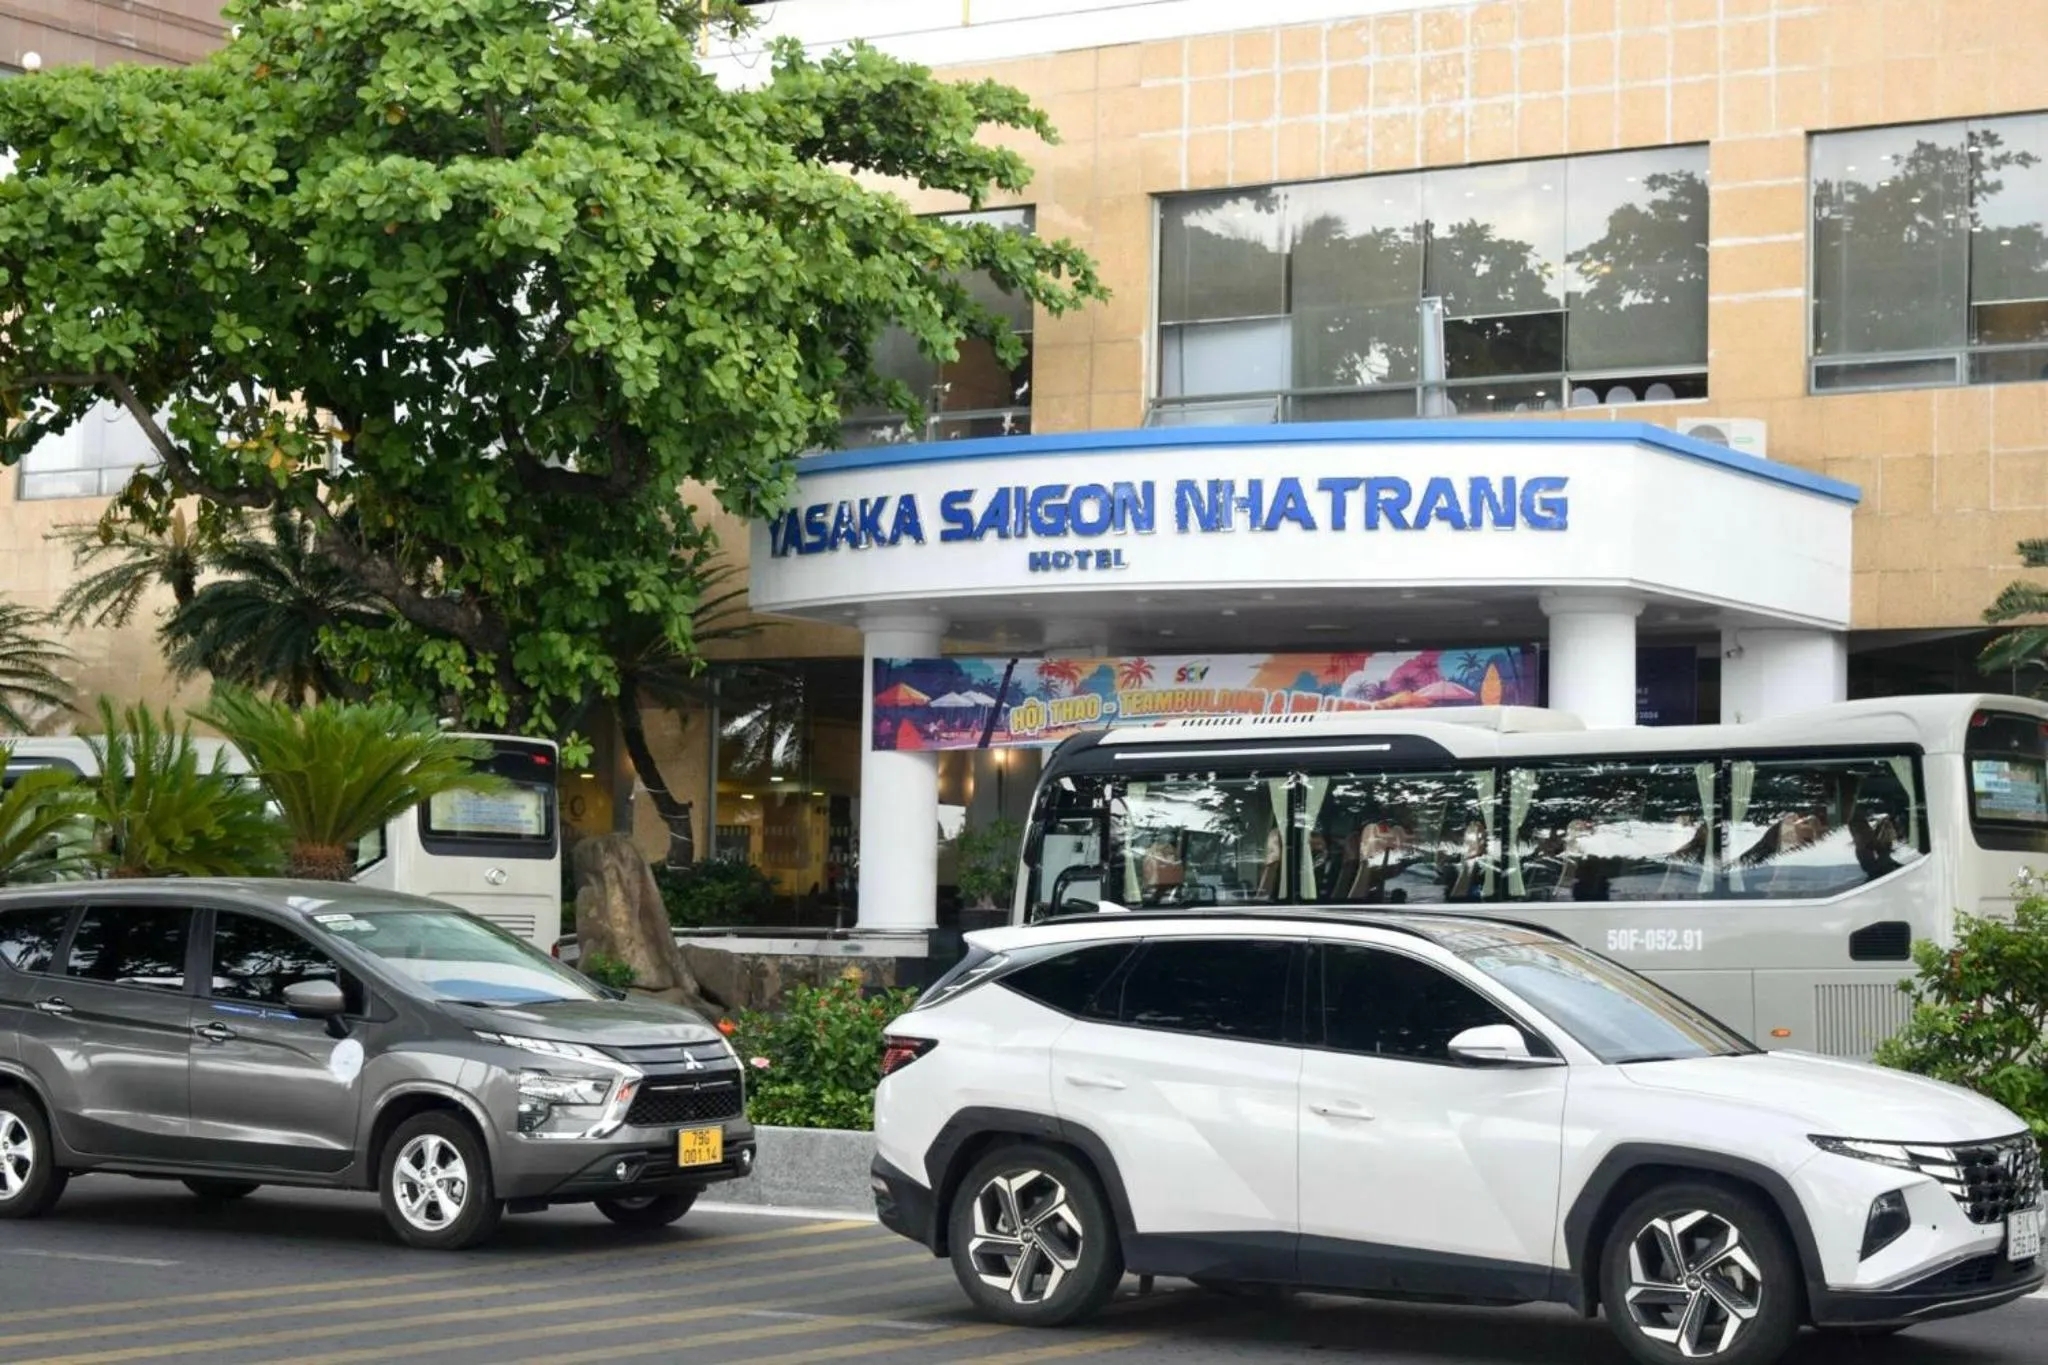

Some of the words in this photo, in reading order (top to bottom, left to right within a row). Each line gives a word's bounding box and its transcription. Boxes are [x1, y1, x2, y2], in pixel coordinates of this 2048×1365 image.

[769, 493, 925, 558] YASAKA
[940, 480, 1156, 542] SAIGON
[1175, 476, 1569, 533] NHATRANG
[1029, 549, 1130, 571] HOTEL
[1011, 698, 1046, 734] HỘI
[1607, 928, 1703, 951] 50F-052.91
